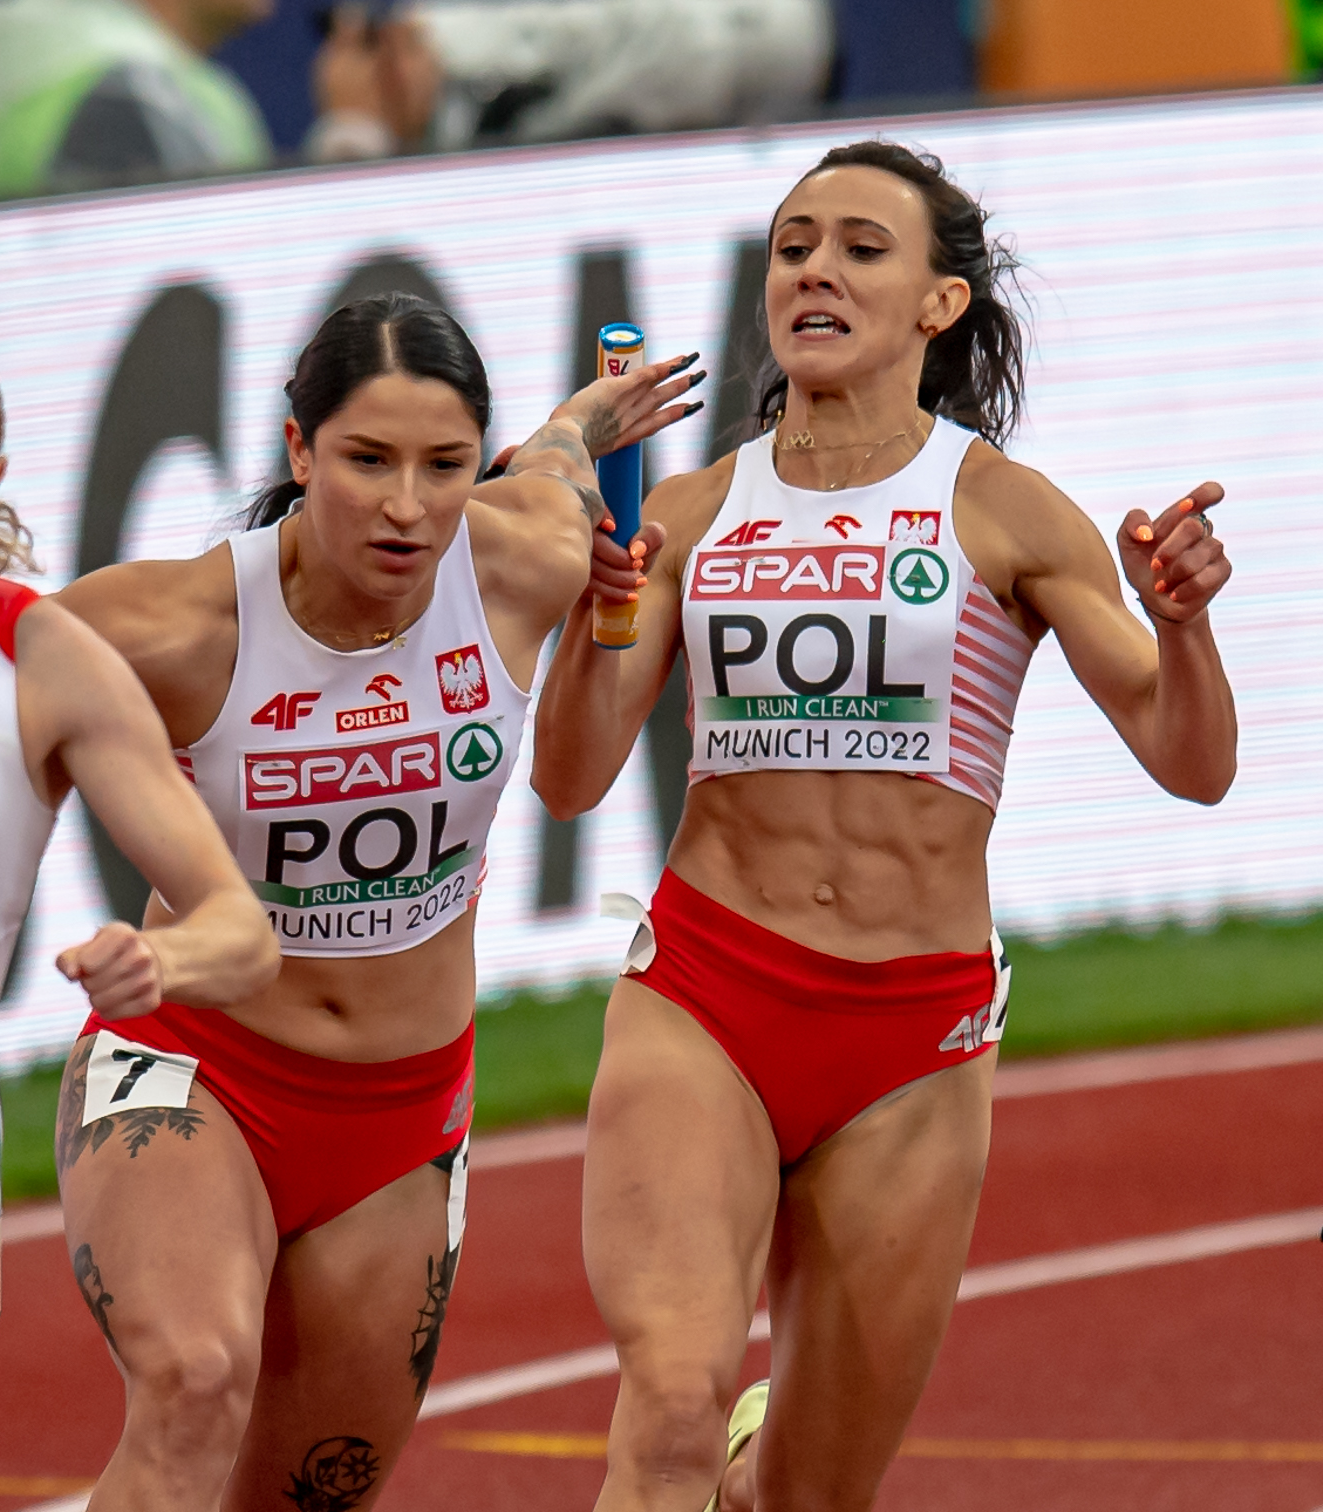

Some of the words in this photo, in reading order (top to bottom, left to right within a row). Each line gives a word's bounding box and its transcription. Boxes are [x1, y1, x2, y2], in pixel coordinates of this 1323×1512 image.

[697, 553, 878, 593] SPAR
[708, 613, 925, 698] POL
[250, 691, 322, 731] 4F
[340, 705, 404, 730] ORLEN
[746, 701, 752, 718] I
[758, 700, 798, 718] RUN
[707, 728, 829, 760] MUNICH
[844, 729, 930, 761] 2022
[251, 742, 435, 801] SPAR
[265, 800, 469, 884] POL
[299, 890, 305, 905] I
[313, 884, 359, 904] RUN
[406, 874, 466, 930] 2022
[110, 1048, 158, 1104] 7
